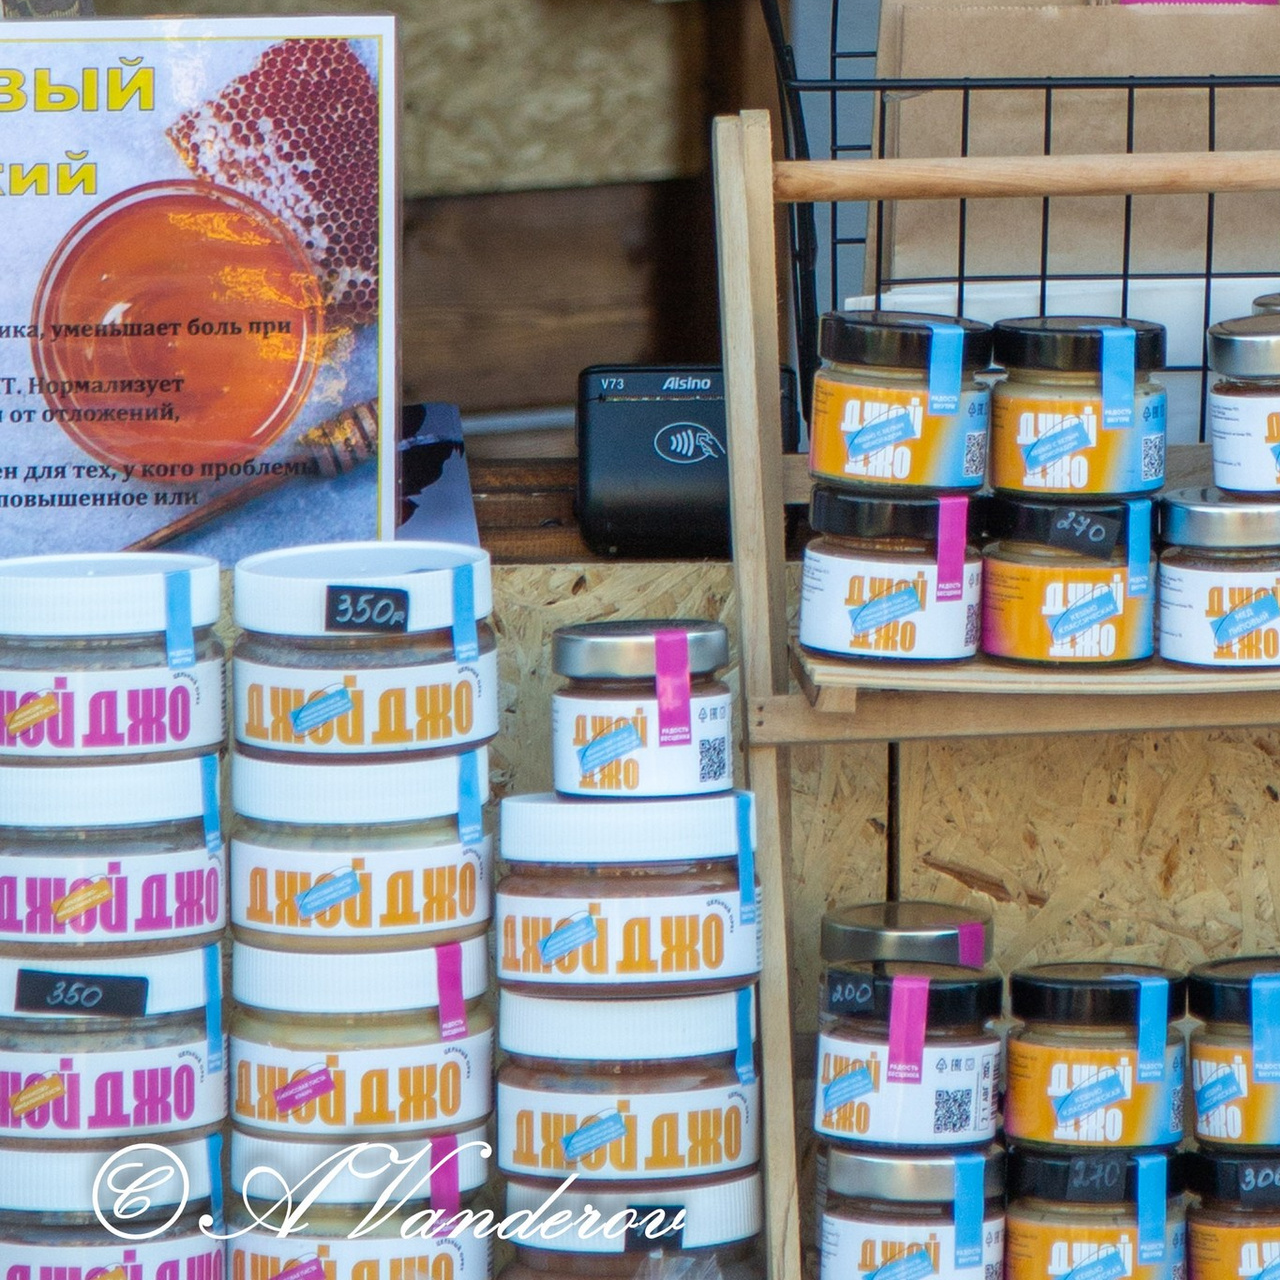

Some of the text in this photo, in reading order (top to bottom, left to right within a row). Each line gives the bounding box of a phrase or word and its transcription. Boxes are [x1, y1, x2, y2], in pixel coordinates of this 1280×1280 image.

[0, 318, 291, 341] ика, уменьшает боль при
[28, 378, 184, 397] Нормализует
[601, 379, 624, 389] V73
[10, 410, 35, 422] от
[42, 405, 180, 423] отложений,
[24, 464, 66, 482] для
[73, 465, 116, 480] тех,
[122, 465, 135, 482] у
[142, 464, 193, 477] кого
[201, 458, 320, 482] проблемы
[154, 493, 199, 506] или
[1057, 511, 1105, 541] 270
[82, 685, 191, 748] ДЖО
[371, 680, 474, 745] ДЖО
[135, 867, 219, 933] ДЖО
[379, 862, 476, 928] ДЖО
[616, 913, 724, 974] ДЖО
[47, 981, 103, 1007] 350
[832, 983, 871, 1003] 200
[88, 1064, 195, 1130] ДЖО
[354, 1061, 461, 1126] ДЖО
[644, 1105, 742, 1171] ДЖО
